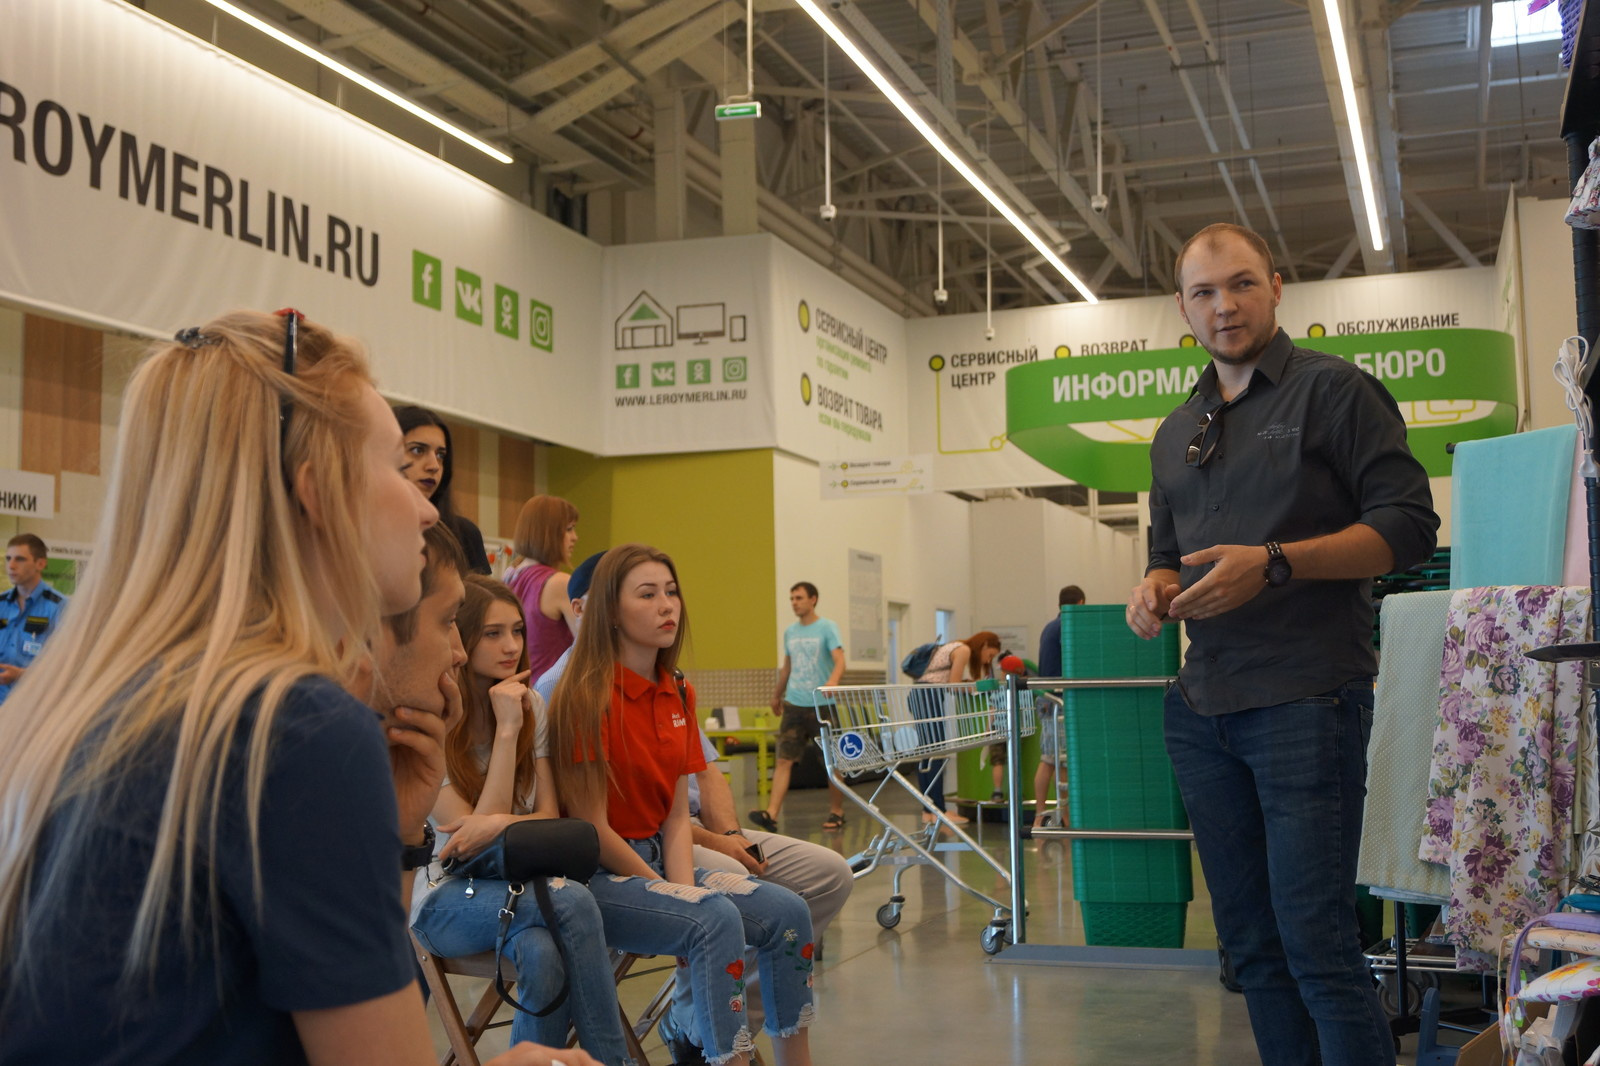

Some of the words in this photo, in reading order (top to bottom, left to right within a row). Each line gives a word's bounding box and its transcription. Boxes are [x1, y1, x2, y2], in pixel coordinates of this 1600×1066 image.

[0, 79, 379, 287] ROYMERLIN.RU
[816, 307, 863, 353] СЕРВИСНЫЙ
[866, 335, 887, 365] ЦЕНТР
[1336, 312, 1460, 336] ОБСЛУЖИВАНИЕ
[951, 344, 1039, 368] СЕРВИСНЫЙ
[1081, 339, 1148, 357] ВОЗВРАТ
[951, 371, 996, 390] ЦЕНТР
[1053, 365, 1207, 404] ИНФОРМА
[615, 389, 747, 407] WWW.LEROYMERLIN.RU
[818, 384, 853, 419] ВОЗВРАТ
[855, 401, 883, 432] ТОВАРА
[0, 490, 37, 512] НИКИ
